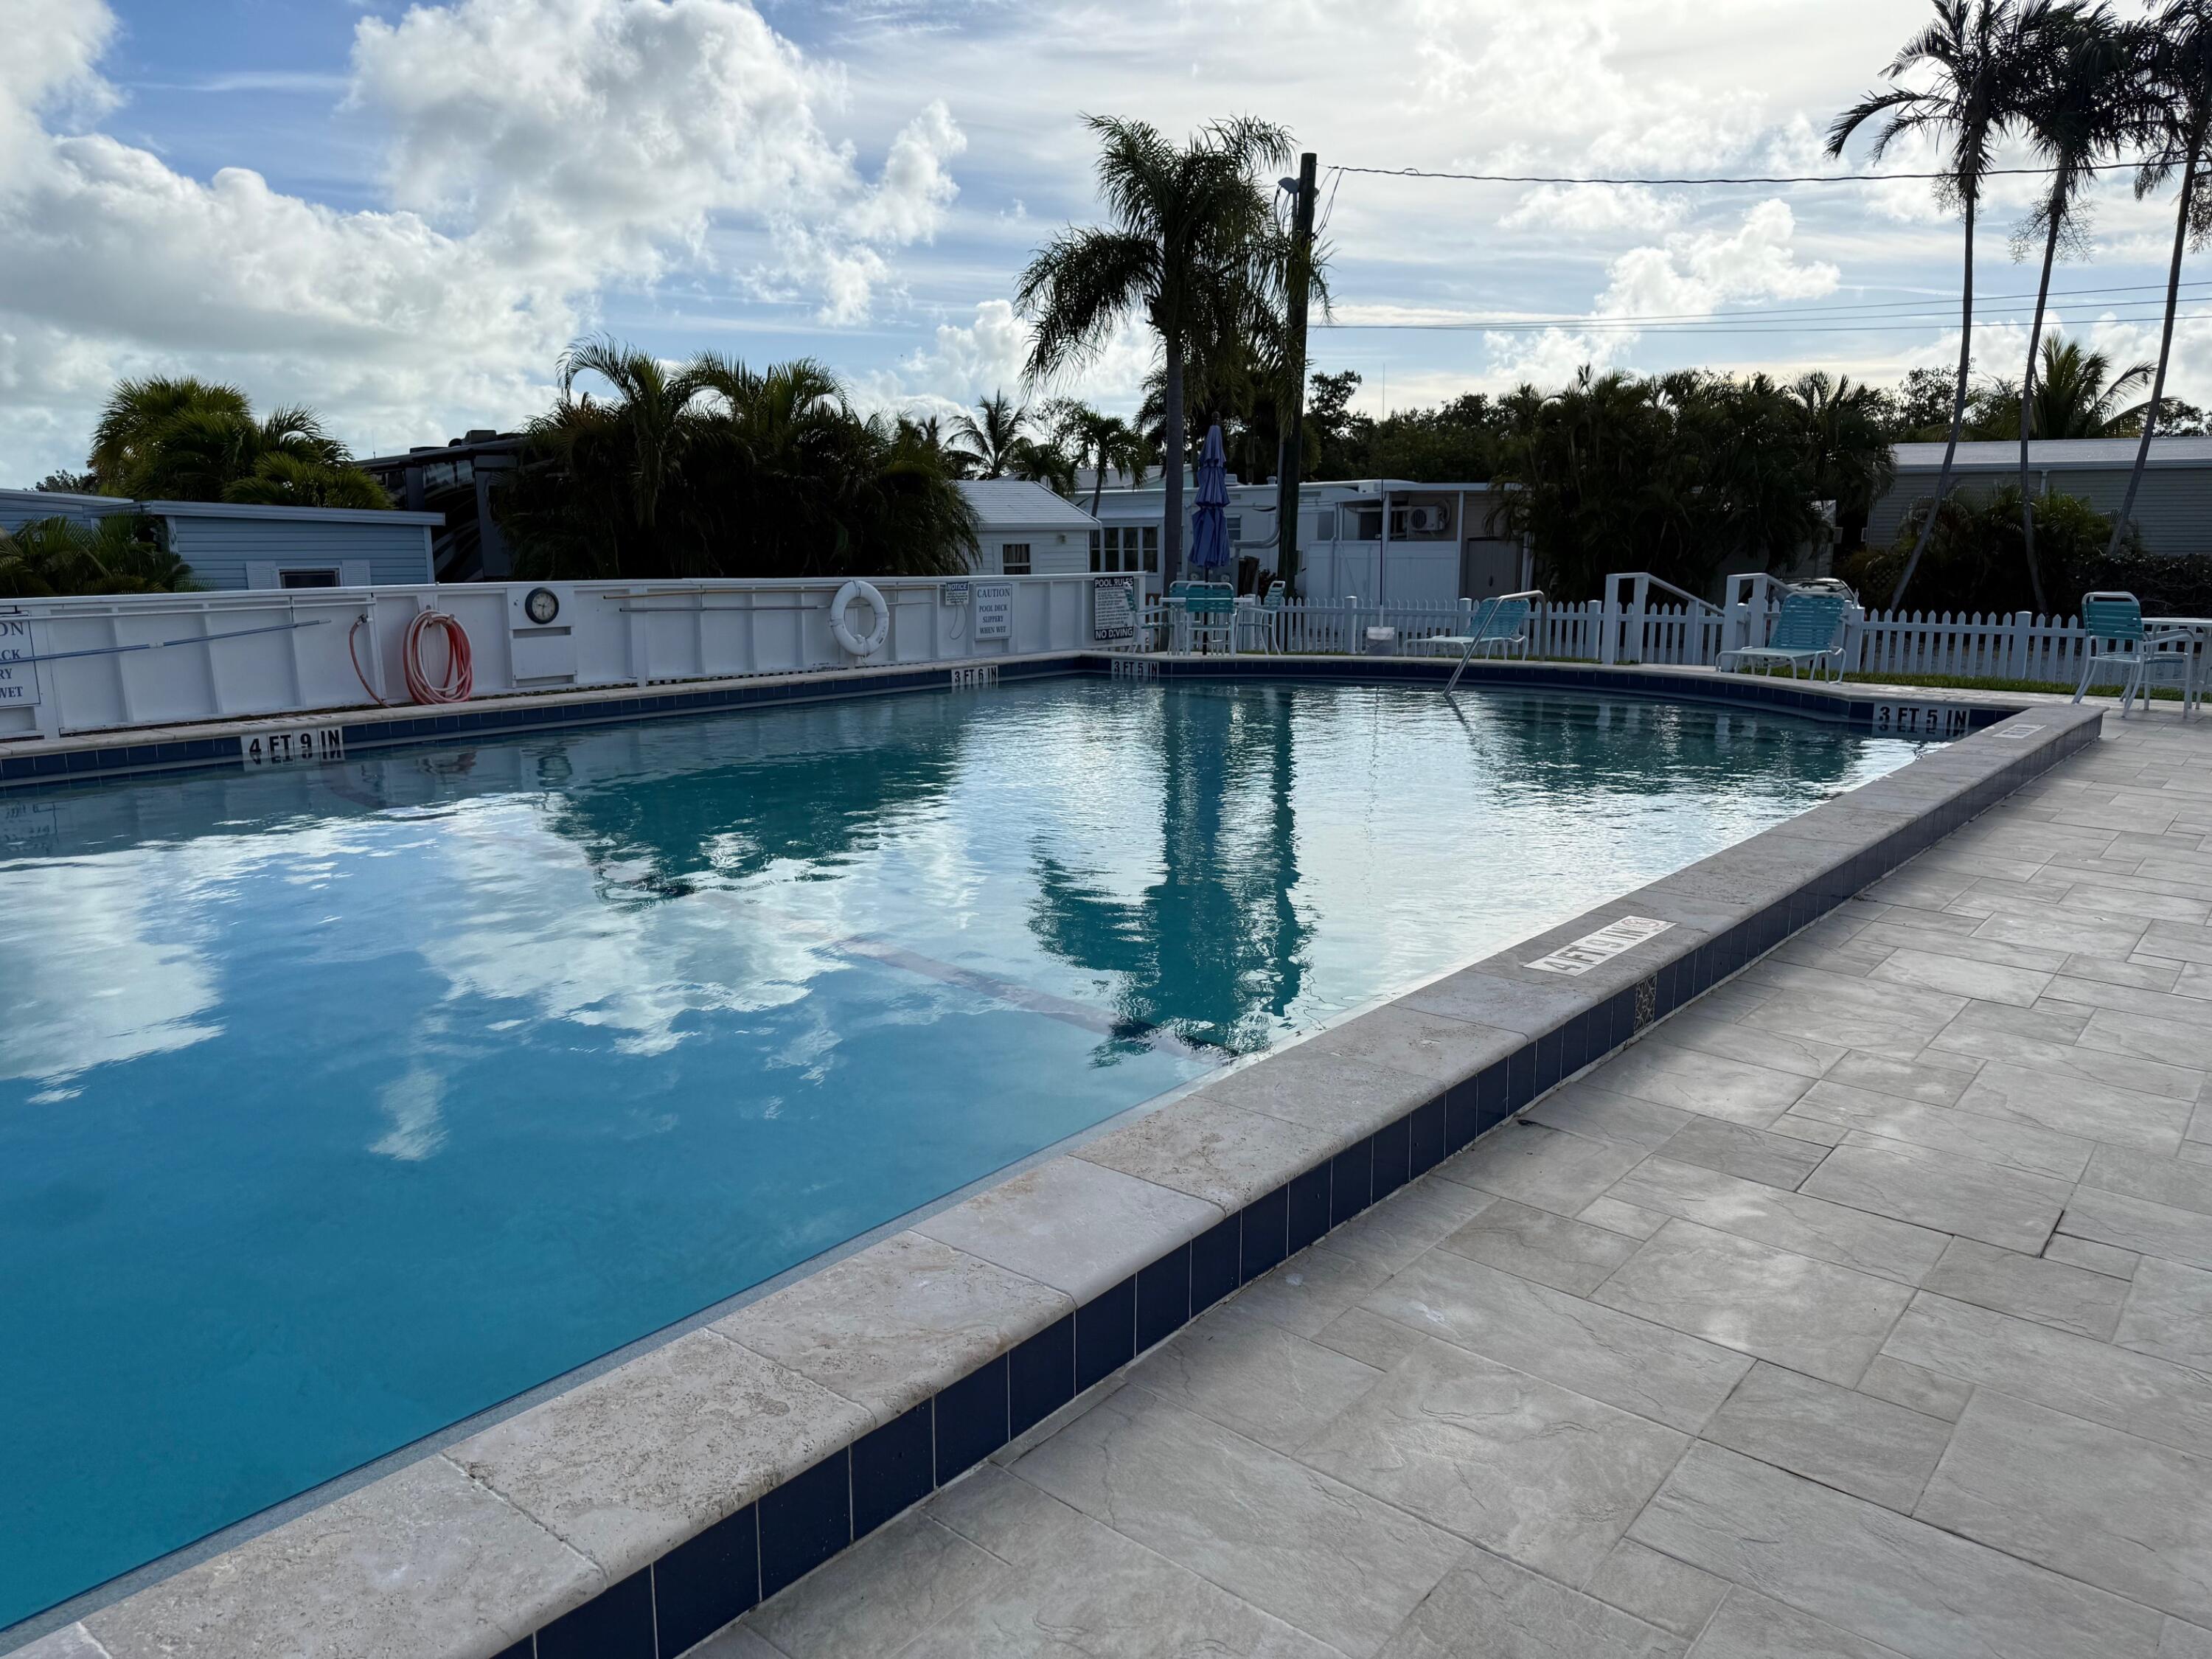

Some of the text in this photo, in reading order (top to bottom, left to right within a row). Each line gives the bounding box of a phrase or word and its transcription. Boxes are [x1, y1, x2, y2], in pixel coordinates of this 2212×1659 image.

[1095, 578, 1113, 587] POOL
[977, 588, 1010, 598] CAUTION
[979, 605, 993, 613] POOL
[983, 615, 1003, 623] SLIPPERY
[979, 627, 995, 635] WHEN
[1096, 630, 1107, 639] NO
[1115, 661, 1157, 677] 3 FT 5 IN
[964, 669, 974, 686] FT
[987, 667, 997, 684] IN
[1879, 706, 1966, 728] 3 FT 5 IN
[249, 729, 340, 757] 4 FT 9 IN
[1599, 927, 1649, 940] IN
[1585, 939, 1624, 948] 9
[1555, 946, 1607, 963] FT
[1543, 961, 1582, 970] 4
